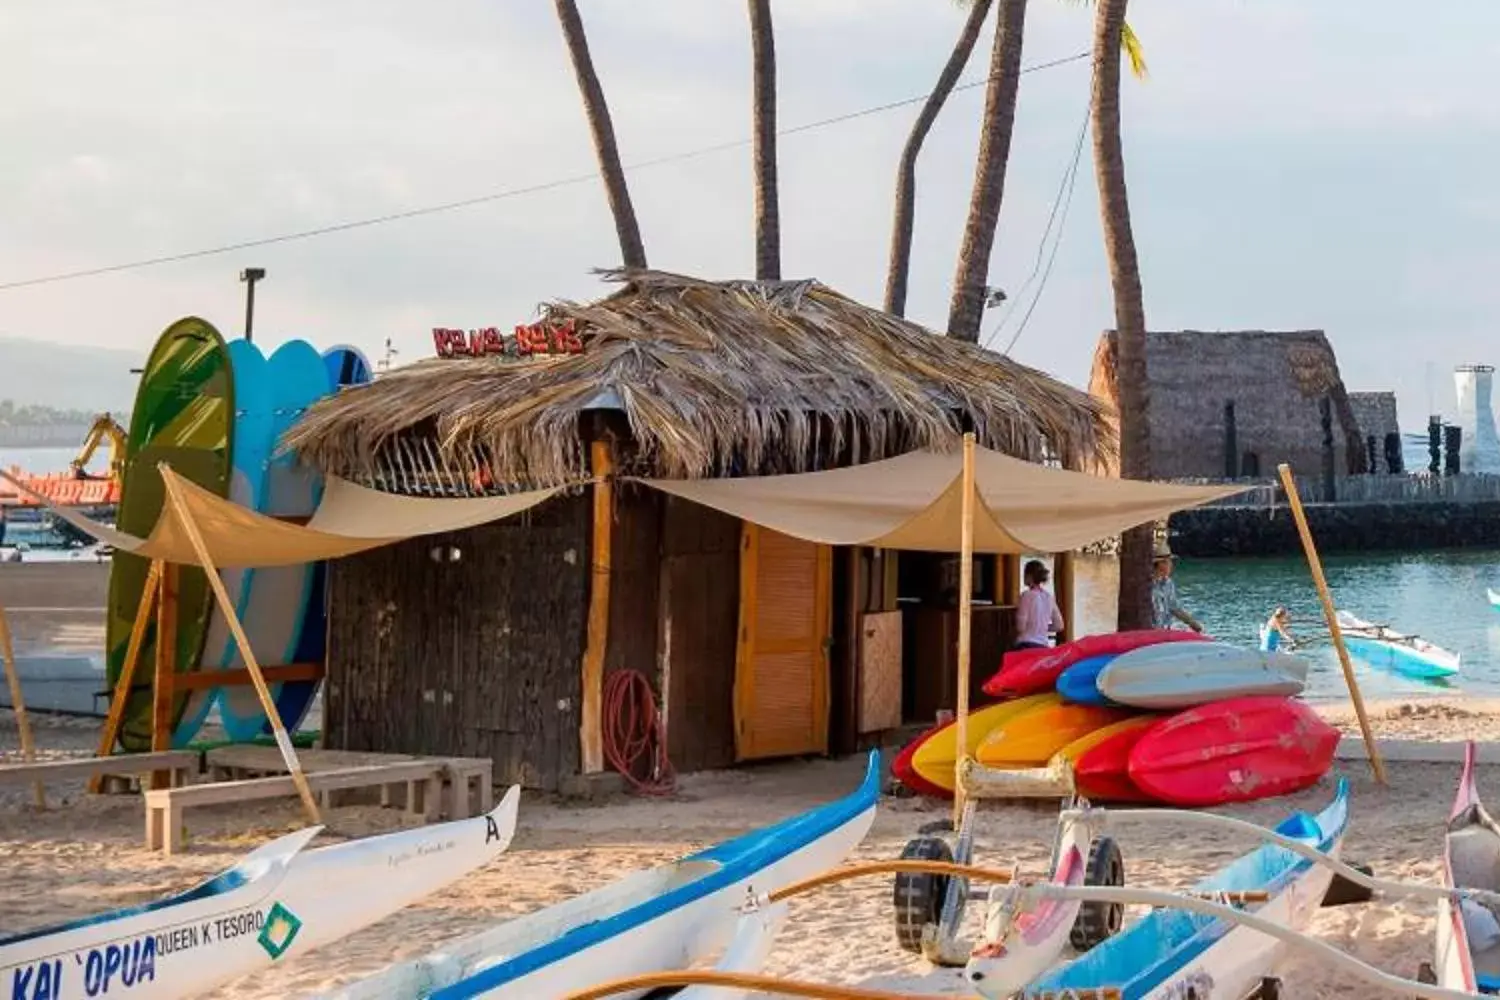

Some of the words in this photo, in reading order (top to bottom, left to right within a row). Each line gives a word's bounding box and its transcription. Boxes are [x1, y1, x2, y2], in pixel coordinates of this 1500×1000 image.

[432, 327, 504, 357] KONA
[485, 815, 500, 845] A
[156, 926, 198, 957] QUEEN
[202, 922, 212, 945] K
[215, 910, 264, 940] TESORO
[12, 959, 62, 1000] KAI
